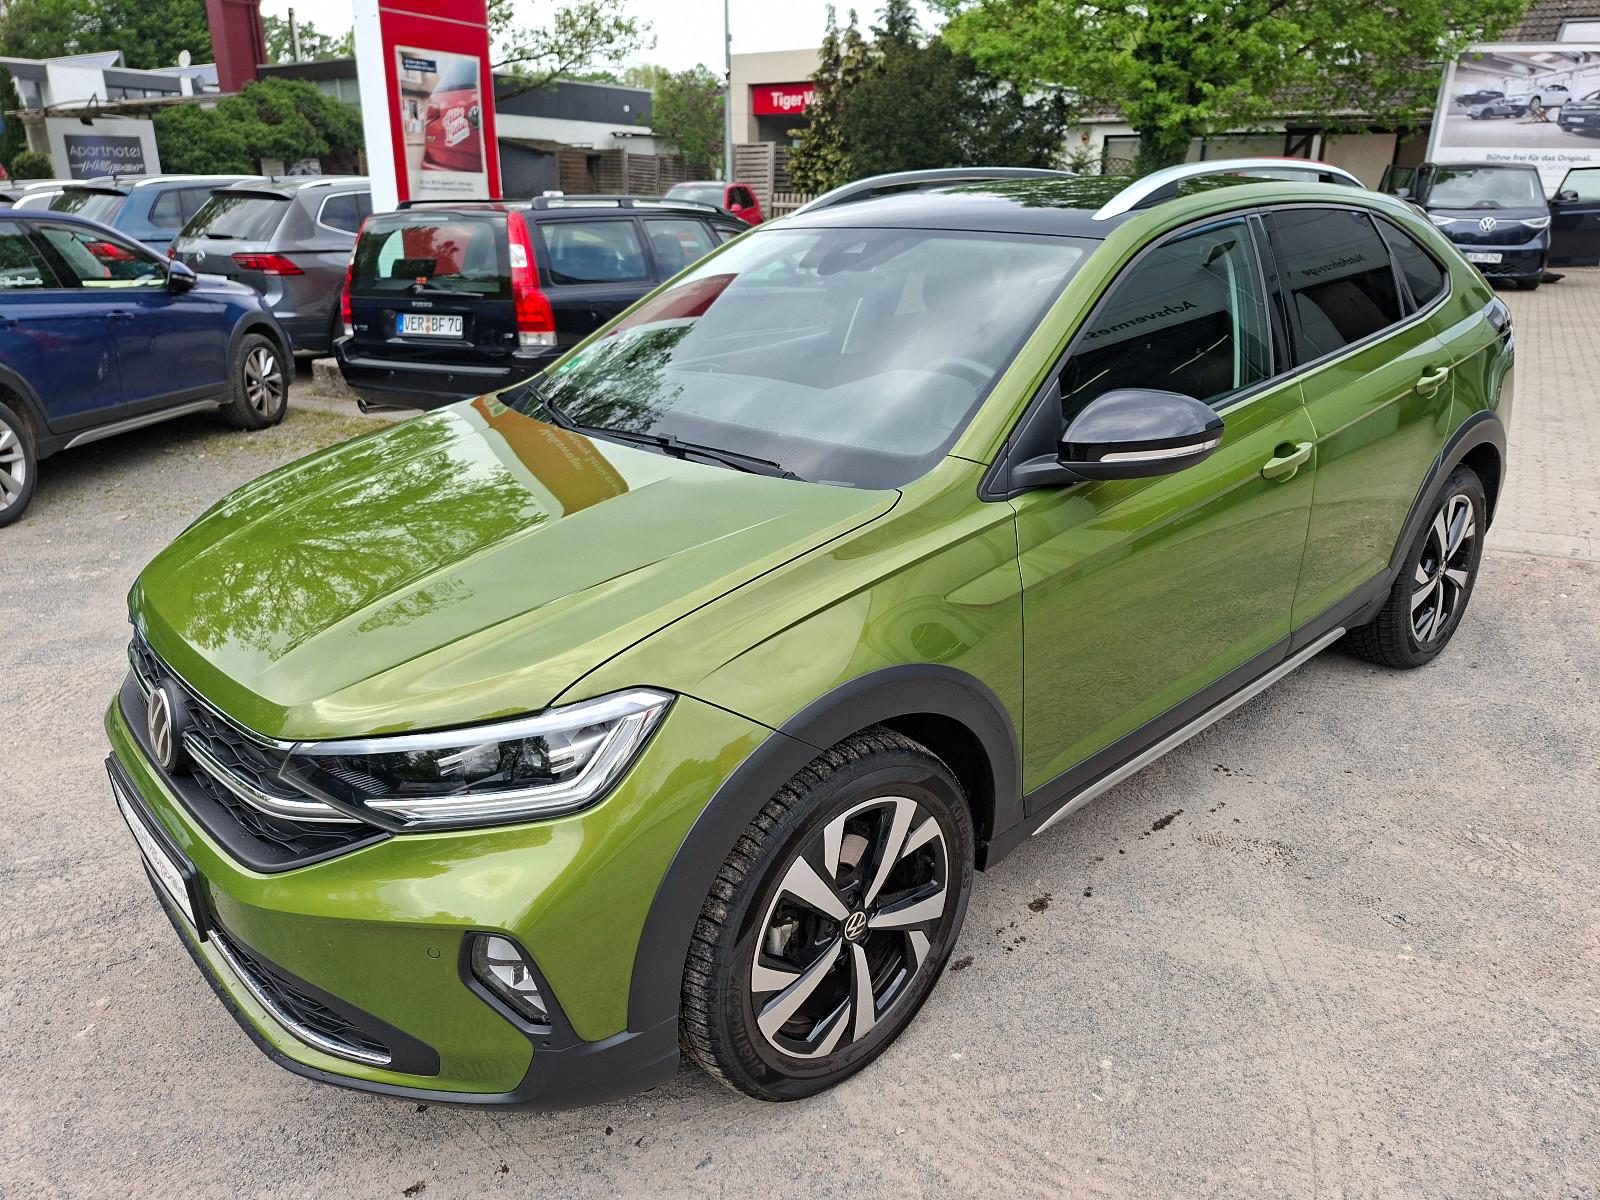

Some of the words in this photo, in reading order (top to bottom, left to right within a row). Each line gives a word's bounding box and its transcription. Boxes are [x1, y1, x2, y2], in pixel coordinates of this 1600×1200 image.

[70, 144, 140, 158] Aparthotel
[404, 316, 425, 331] VER
[431, 317, 445, 332] BF
[448, 318, 462, 332] 70
